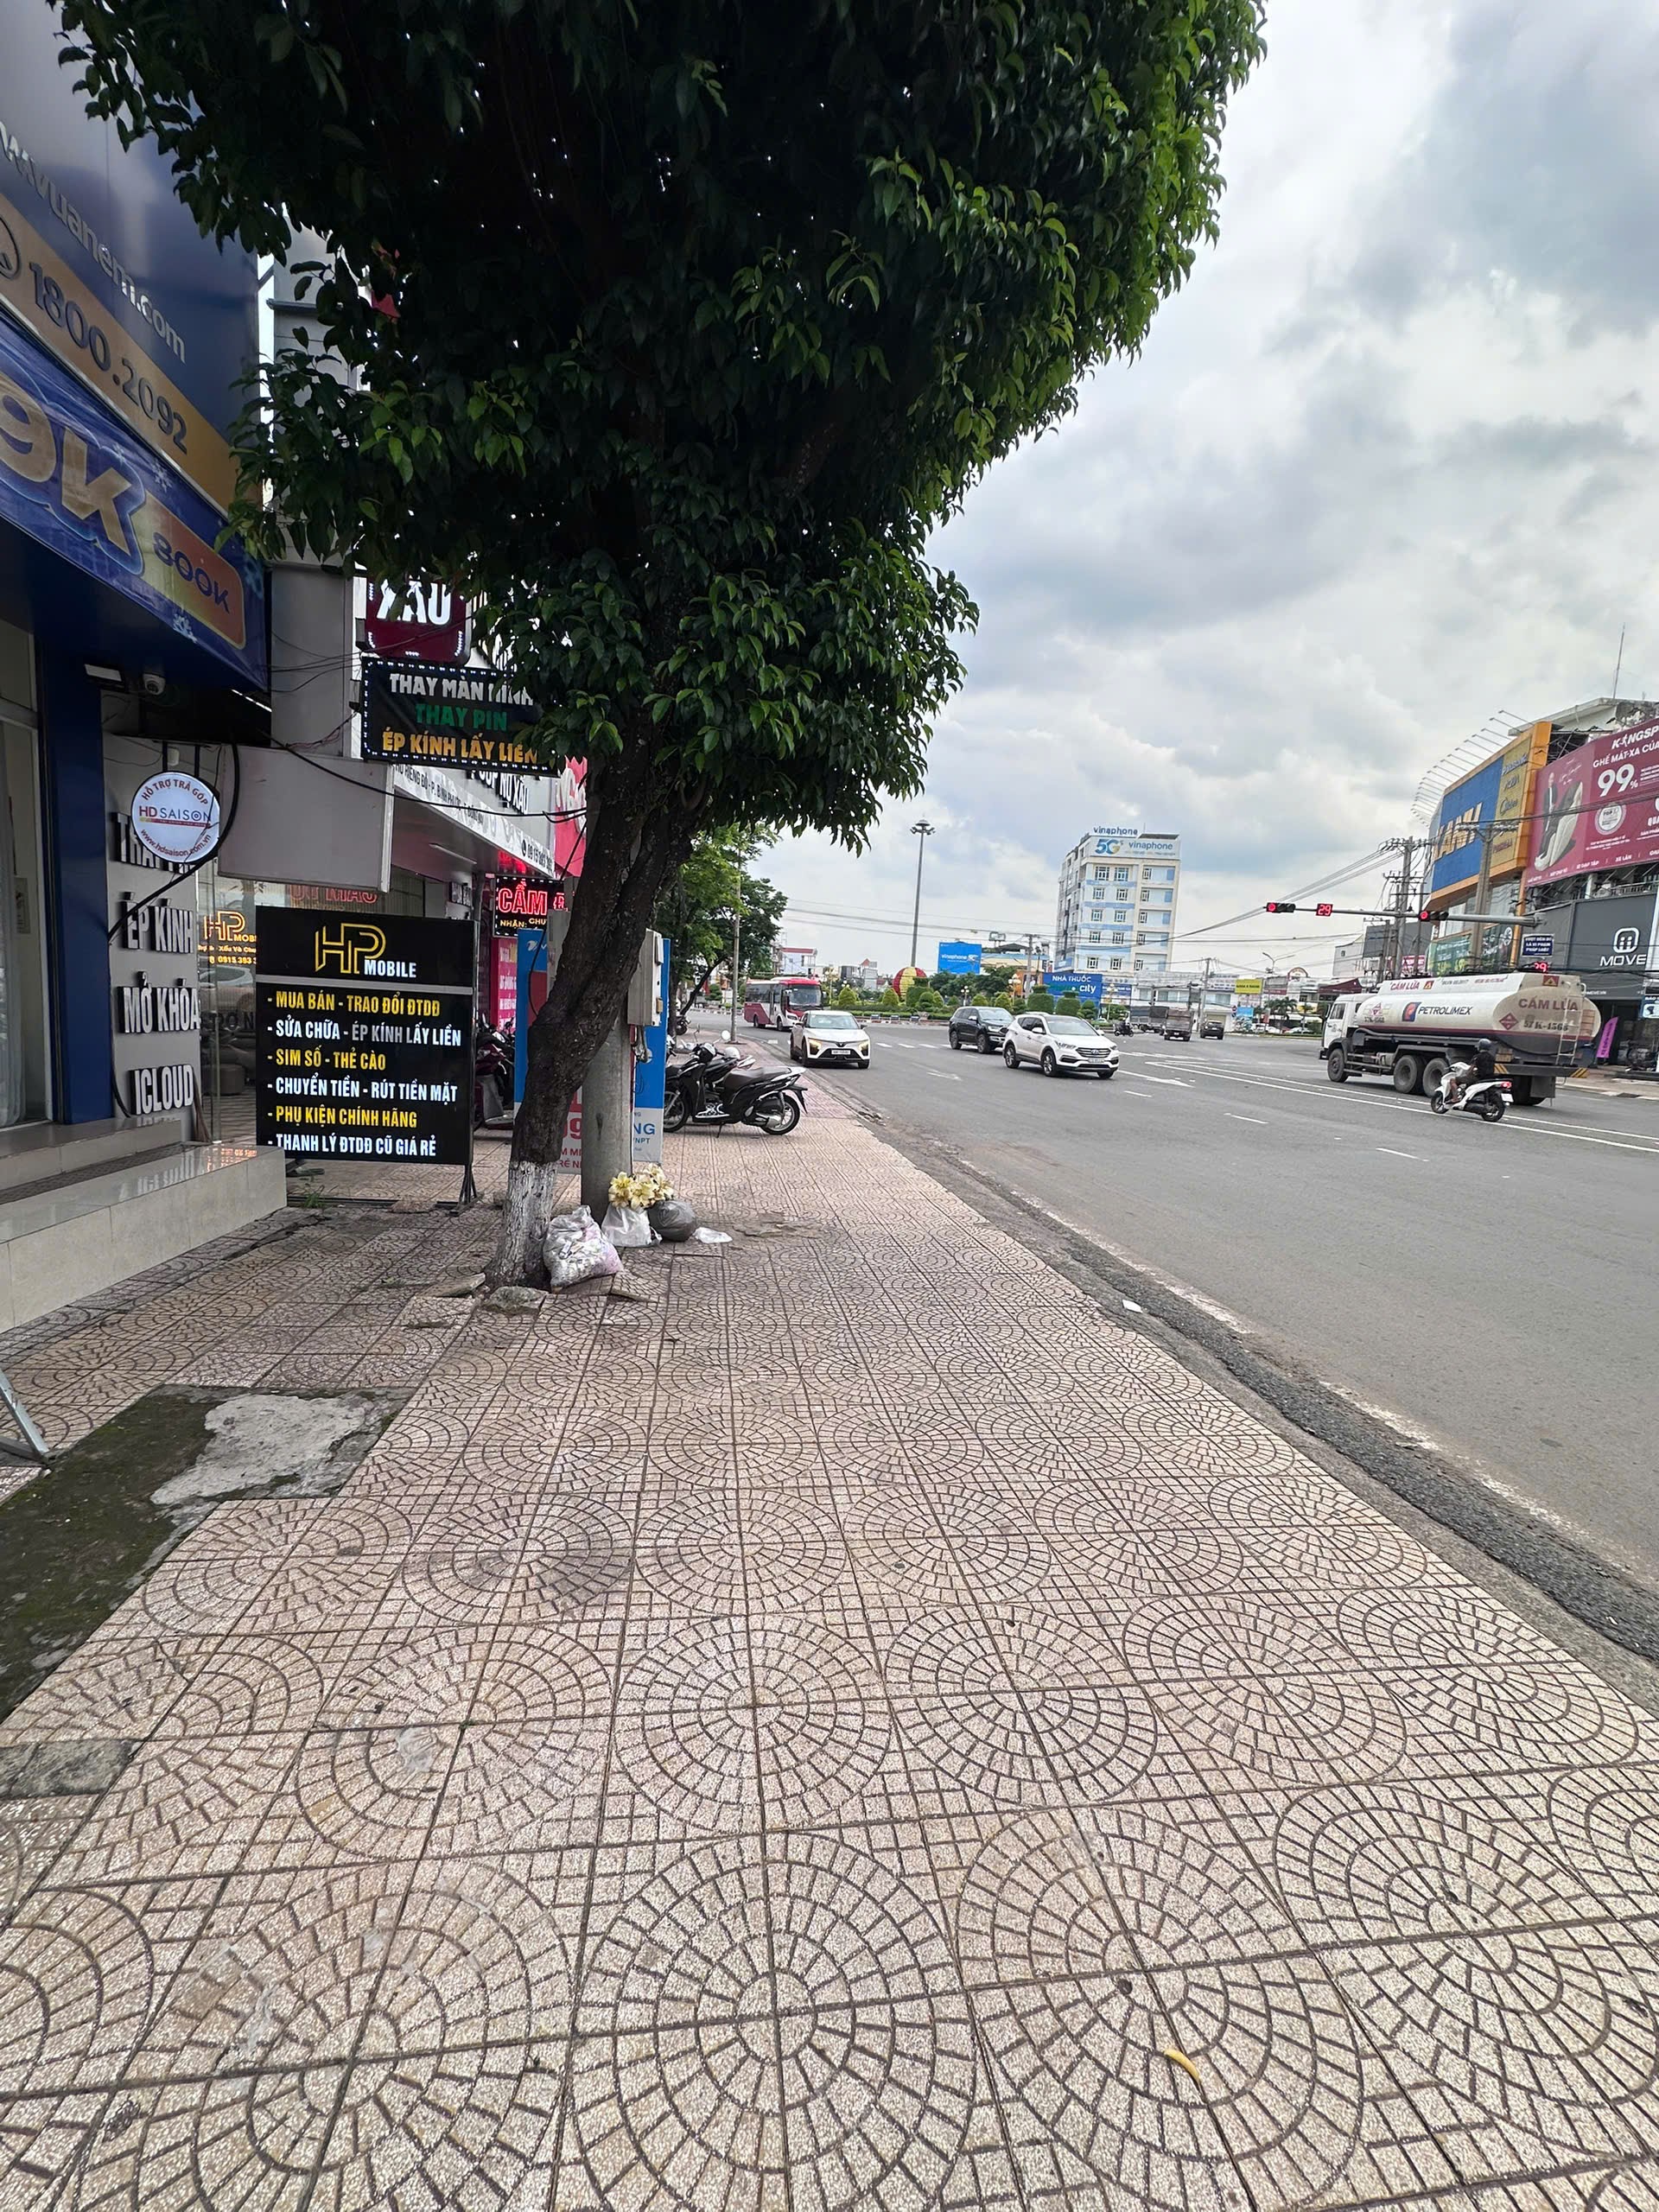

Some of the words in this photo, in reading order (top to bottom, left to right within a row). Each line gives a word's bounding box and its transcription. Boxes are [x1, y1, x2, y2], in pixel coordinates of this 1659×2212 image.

[29, 263, 188, 455] 1800.2092
[390, 673, 438, 696] THAY
[442, 676, 484, 702] MÀN
[416, 703, 470, 730] THAY
[473, 709, 508, 731] PIN
[382, 727, 405, 752] ÉP
[410, 730, 455, 757] KÍNH
[461, 734, 495, 760] LẤY
[139, 805, 157, 817] HD
[160, 807, 212, 822] SAISON
[1093, 826, 1138, 836] vinaphone
[1128, 841, 1173, 850] vinaphone
[1318, 905, 1332, 916] 29
[154, 898, 194, 954] KÍNH
[364, 959, 416, 978] MOBILE
[1600, 954, 1647, 967] MOVE
[123, 971, 154, 1033] MỞ
[156, 978, 201, 1032] KHÓA
[276, 990, 304, 1009] MUA
[308, 989, 335, 1010] BÁN
[346, 995, 378, 1014] TRAO
[382, 991, 404, 1015] ĐỔI
[407, 998, 441, 1017] ĐTDĐ
[1418, 1006, 1473, 1015] PETROLIMEX
[276, 1014, 302, 1037] SỬA
[305, 1019, 340, 1039] CHỮA
[352, 1020, 368, 1041] ÉP
[372, 1021, 403, 1044] KÍNH
[406, 1021, 430, 1045] LẤY
[432, 1023, 461, 1046] LIỀN
[276, 1048, 302, 1066] SIM
[304, 1045, 322, 1067] SỐ
[333, 1046, 357, 1069] THẺ
[359, 1050, 386, 1071] CÀO
[134, 1065, 194, 1115] ICLOUD
[276, 1071, 327, 1096] CHUYỂN
[330, 1075, 360, 1097] TIỀN
[371, 1078, 396, 1099] RÚT
[398, 1078, 428, 1101] TIỀN
[430, 1082, 458, 1105] MẶT
[276, 1105, 302, 1127] PHỤ
[305, 1103, 336, 1128] KIỆN
[339, 1106, 379, 1127] CHÍNH
[382, 1107, 417, 1128] HÃNG
[276, 1134, 319, 1152] THANH
[321, 1132, 337, 1153] LÝ
[339, 1135, 372, 1154] ĐTDĐ
[376, 1135, 393, 1155] CŨ
[396, 1135, 417, 1156] GIÁ
[420, 1134, 436, 1157] RẺ
